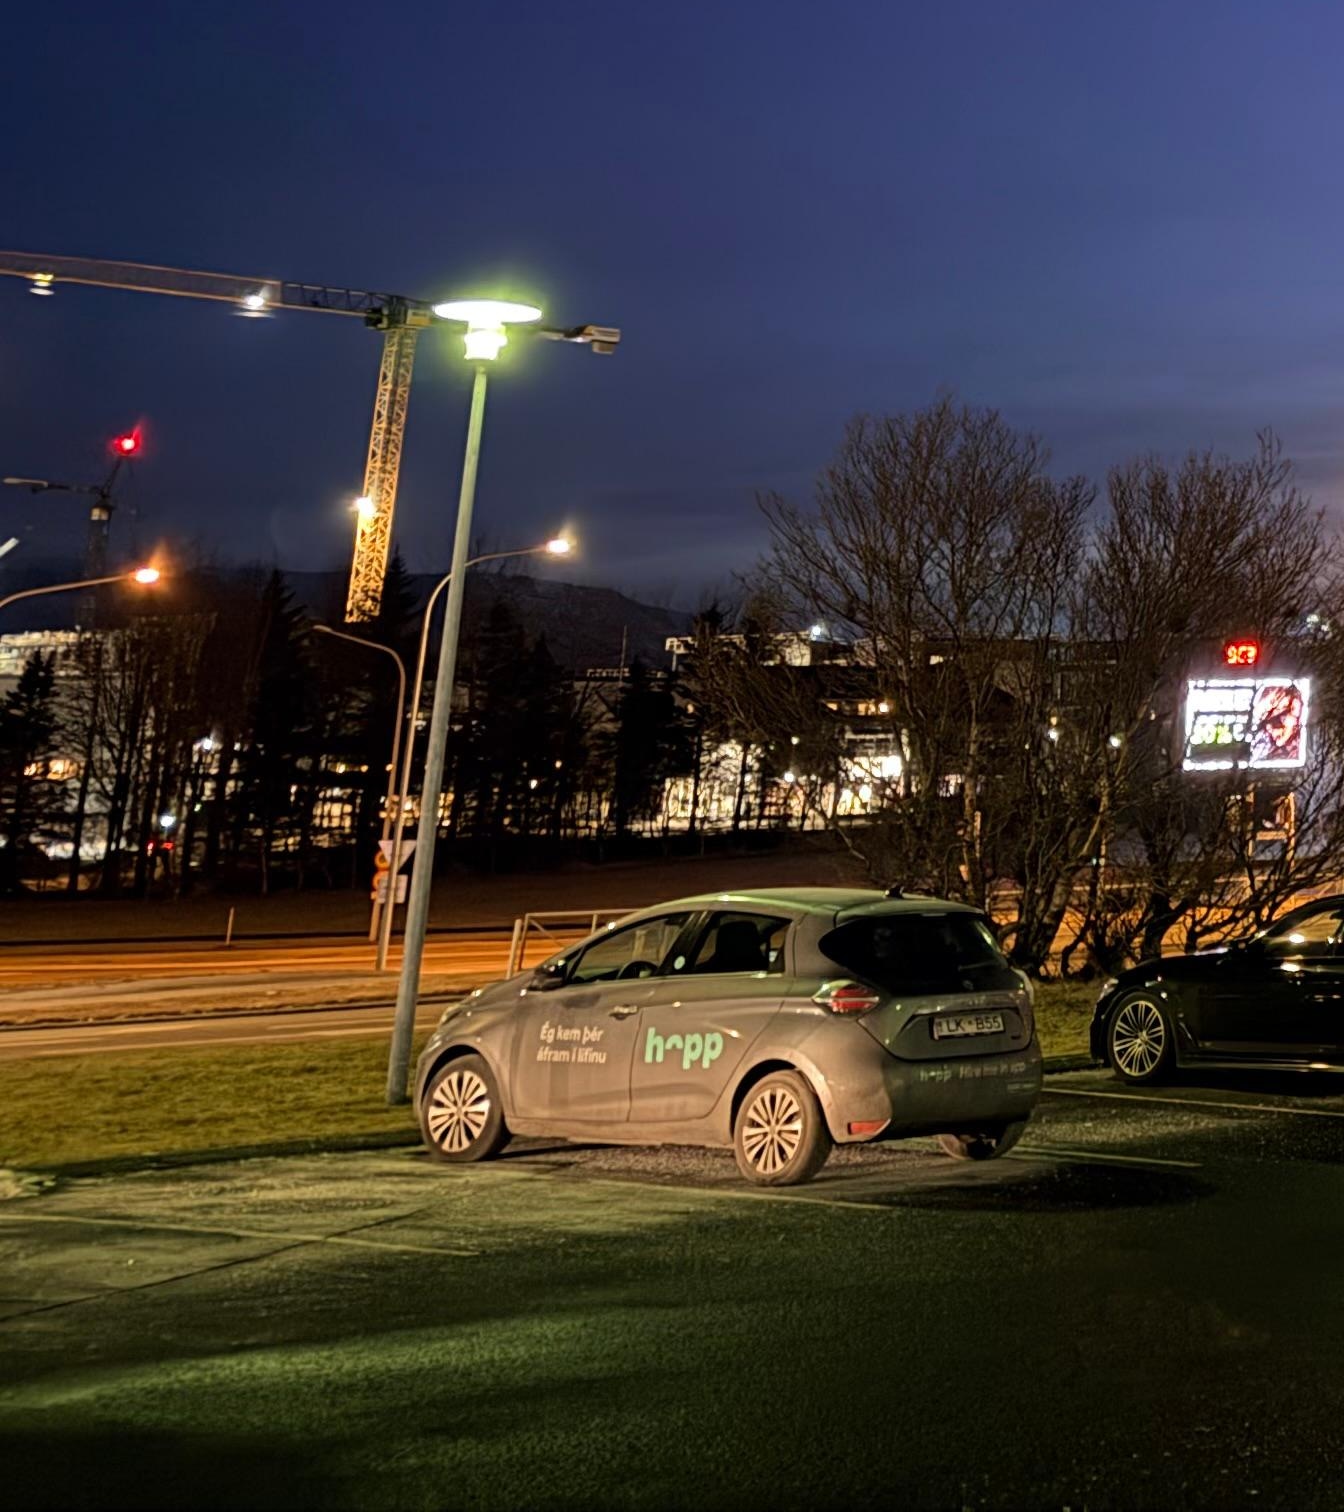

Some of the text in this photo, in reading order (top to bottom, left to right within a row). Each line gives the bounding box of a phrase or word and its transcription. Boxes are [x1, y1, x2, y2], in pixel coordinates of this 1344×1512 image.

[540, 1021, 605, 1044] Ég kem þér
[536, 1046, 570, 1063] áfram
